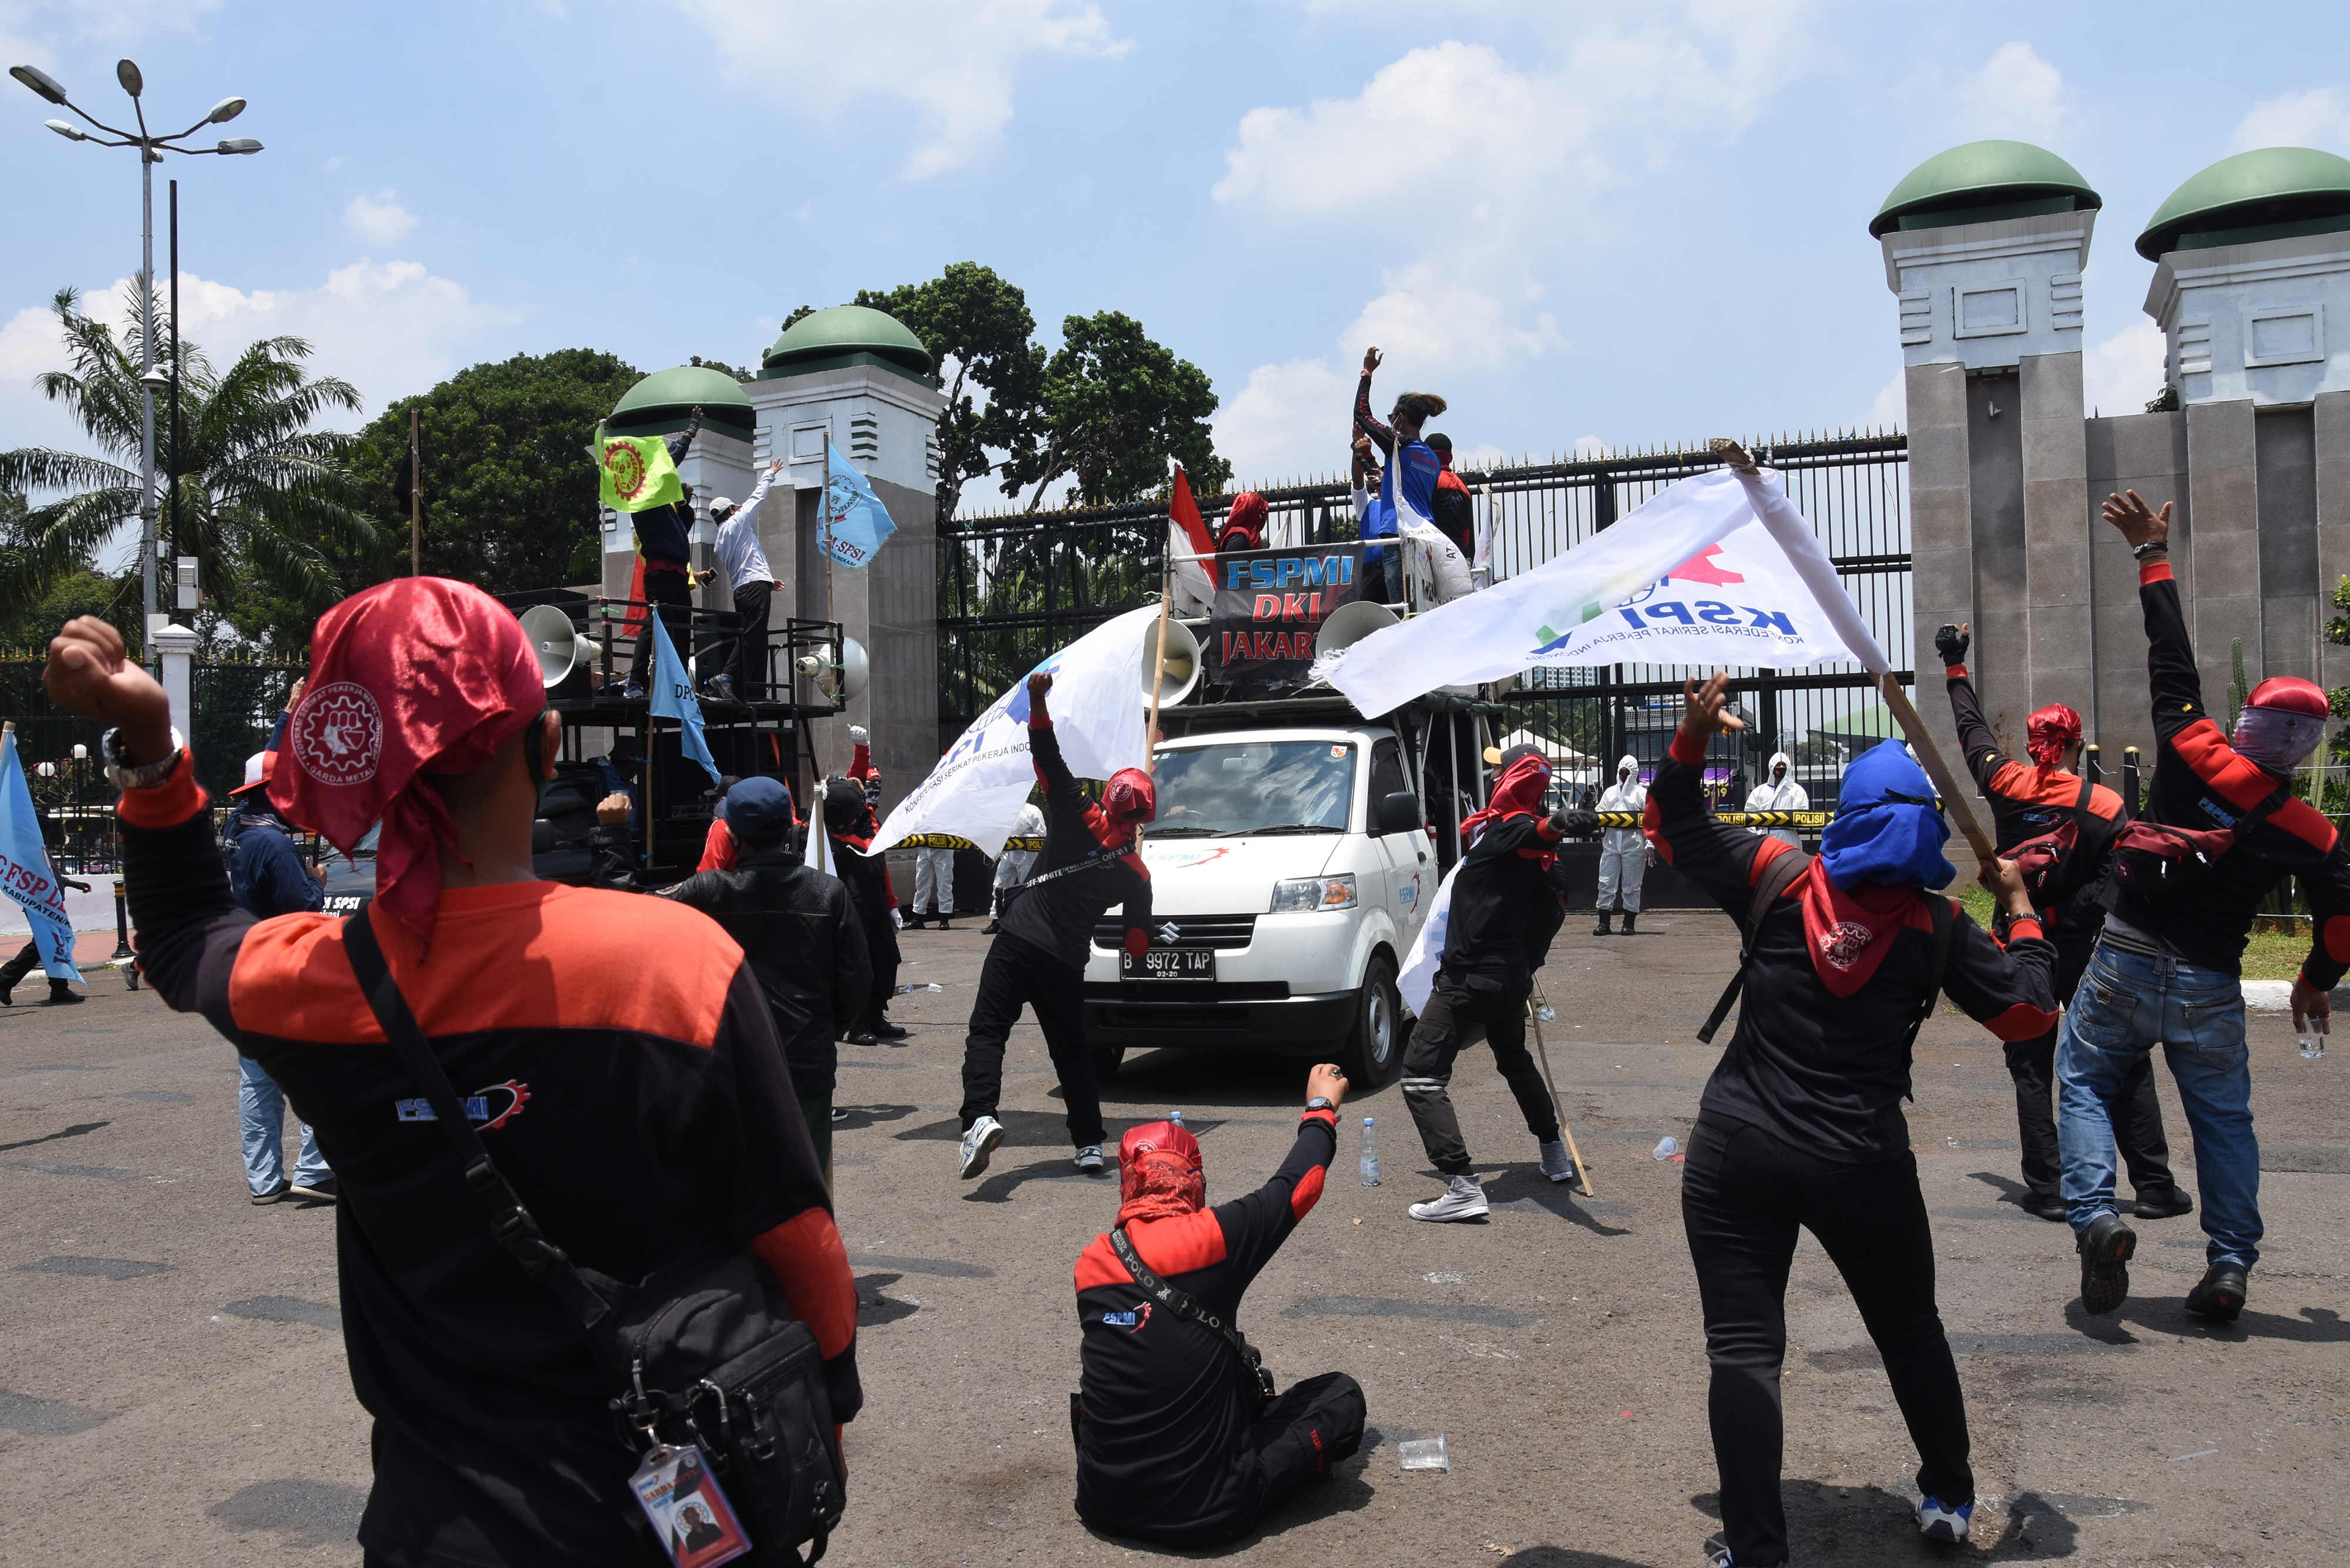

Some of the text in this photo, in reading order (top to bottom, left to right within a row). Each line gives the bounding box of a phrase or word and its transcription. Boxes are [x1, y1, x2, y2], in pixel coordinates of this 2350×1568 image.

[837, 555, 856, 567] BEKASI
[1226, 556, 1353, 589] FSPMI
[1253, 592, 1320, 623] DKI
[1221, 632, 1318, 666] JAKAR
[328, 685, 363, 696] PEKERJA
[299, 690, 327, 717] SERIKAT
[363, 693, 378, 717] METAL
[295, 718, 307, 760] FEDERASI
[944, 757, 971, 780] SERIKAT
[972, 747, 1009, 763] PEKERJA
[1011, 741, 1030, 754] INDO
[310, 765, 375, 783] GARDA METAL
[1795, 814, 1823, 824] POLISI
[2198, 797, 2236, 828] FSPMI
[929, 835, 946, 846] POLISI
[1146, 854, 1202, 862] FSPMI
[1399, 885, 1415, 902] FSPMI
[332, 897, 361, 910] SPSI
[1847, 924, 1869, 936] PEKERJA
[1124, 952, 1210, 969] B 9972 TAP
[1125, 1252, 1155, 1288] POLO
[1103, 1312, 1136, 1325] FSPMI
[644, 1482, 673, 1502] GARDA
